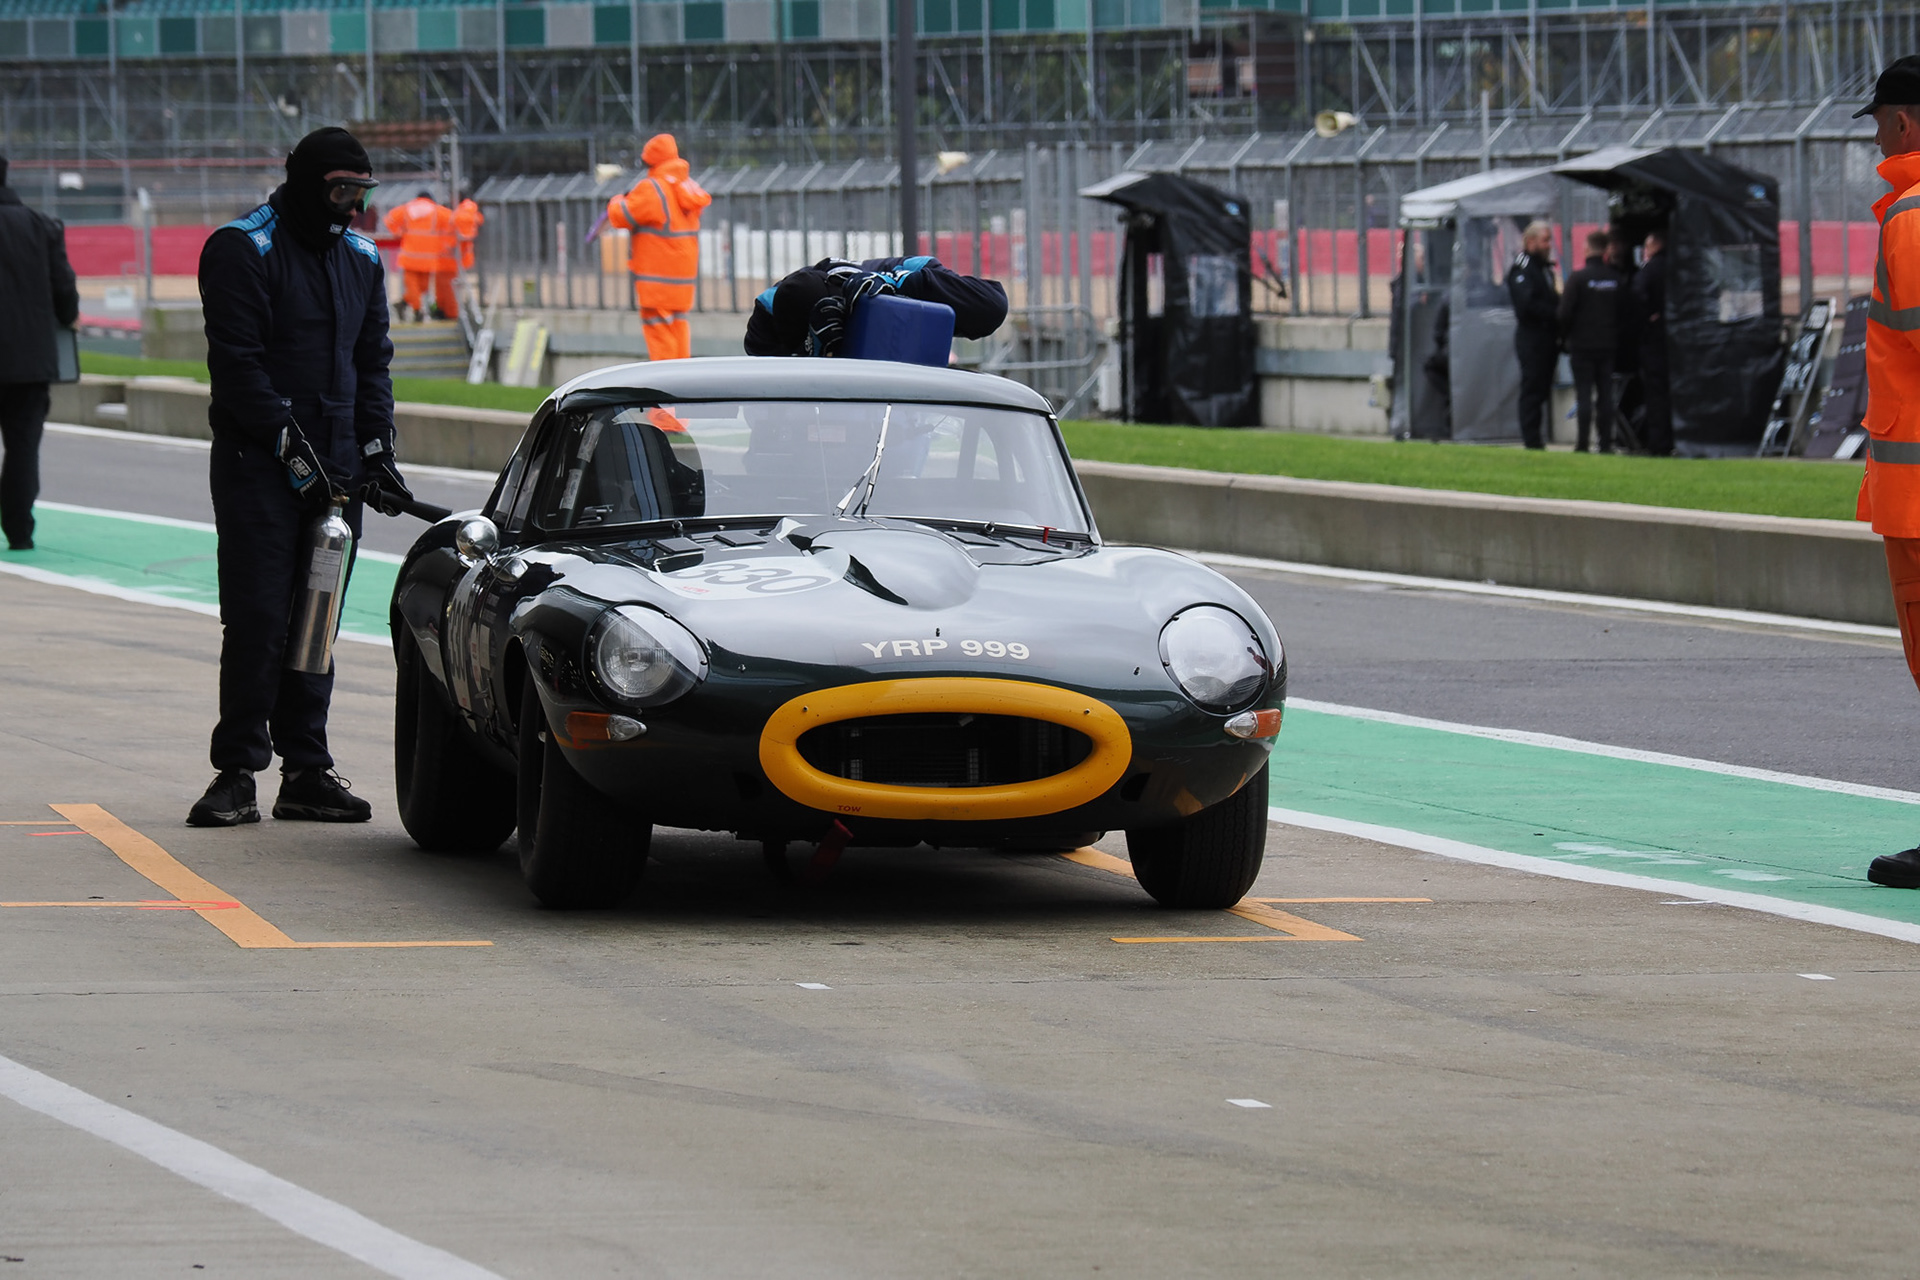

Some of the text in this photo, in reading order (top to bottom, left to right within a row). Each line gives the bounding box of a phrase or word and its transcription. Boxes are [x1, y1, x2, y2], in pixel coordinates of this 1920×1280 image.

[666, 563, 831, 593] 330
[861, 639, 1030, 660] YRP 999
[837, 804, 861, 812] TOW
